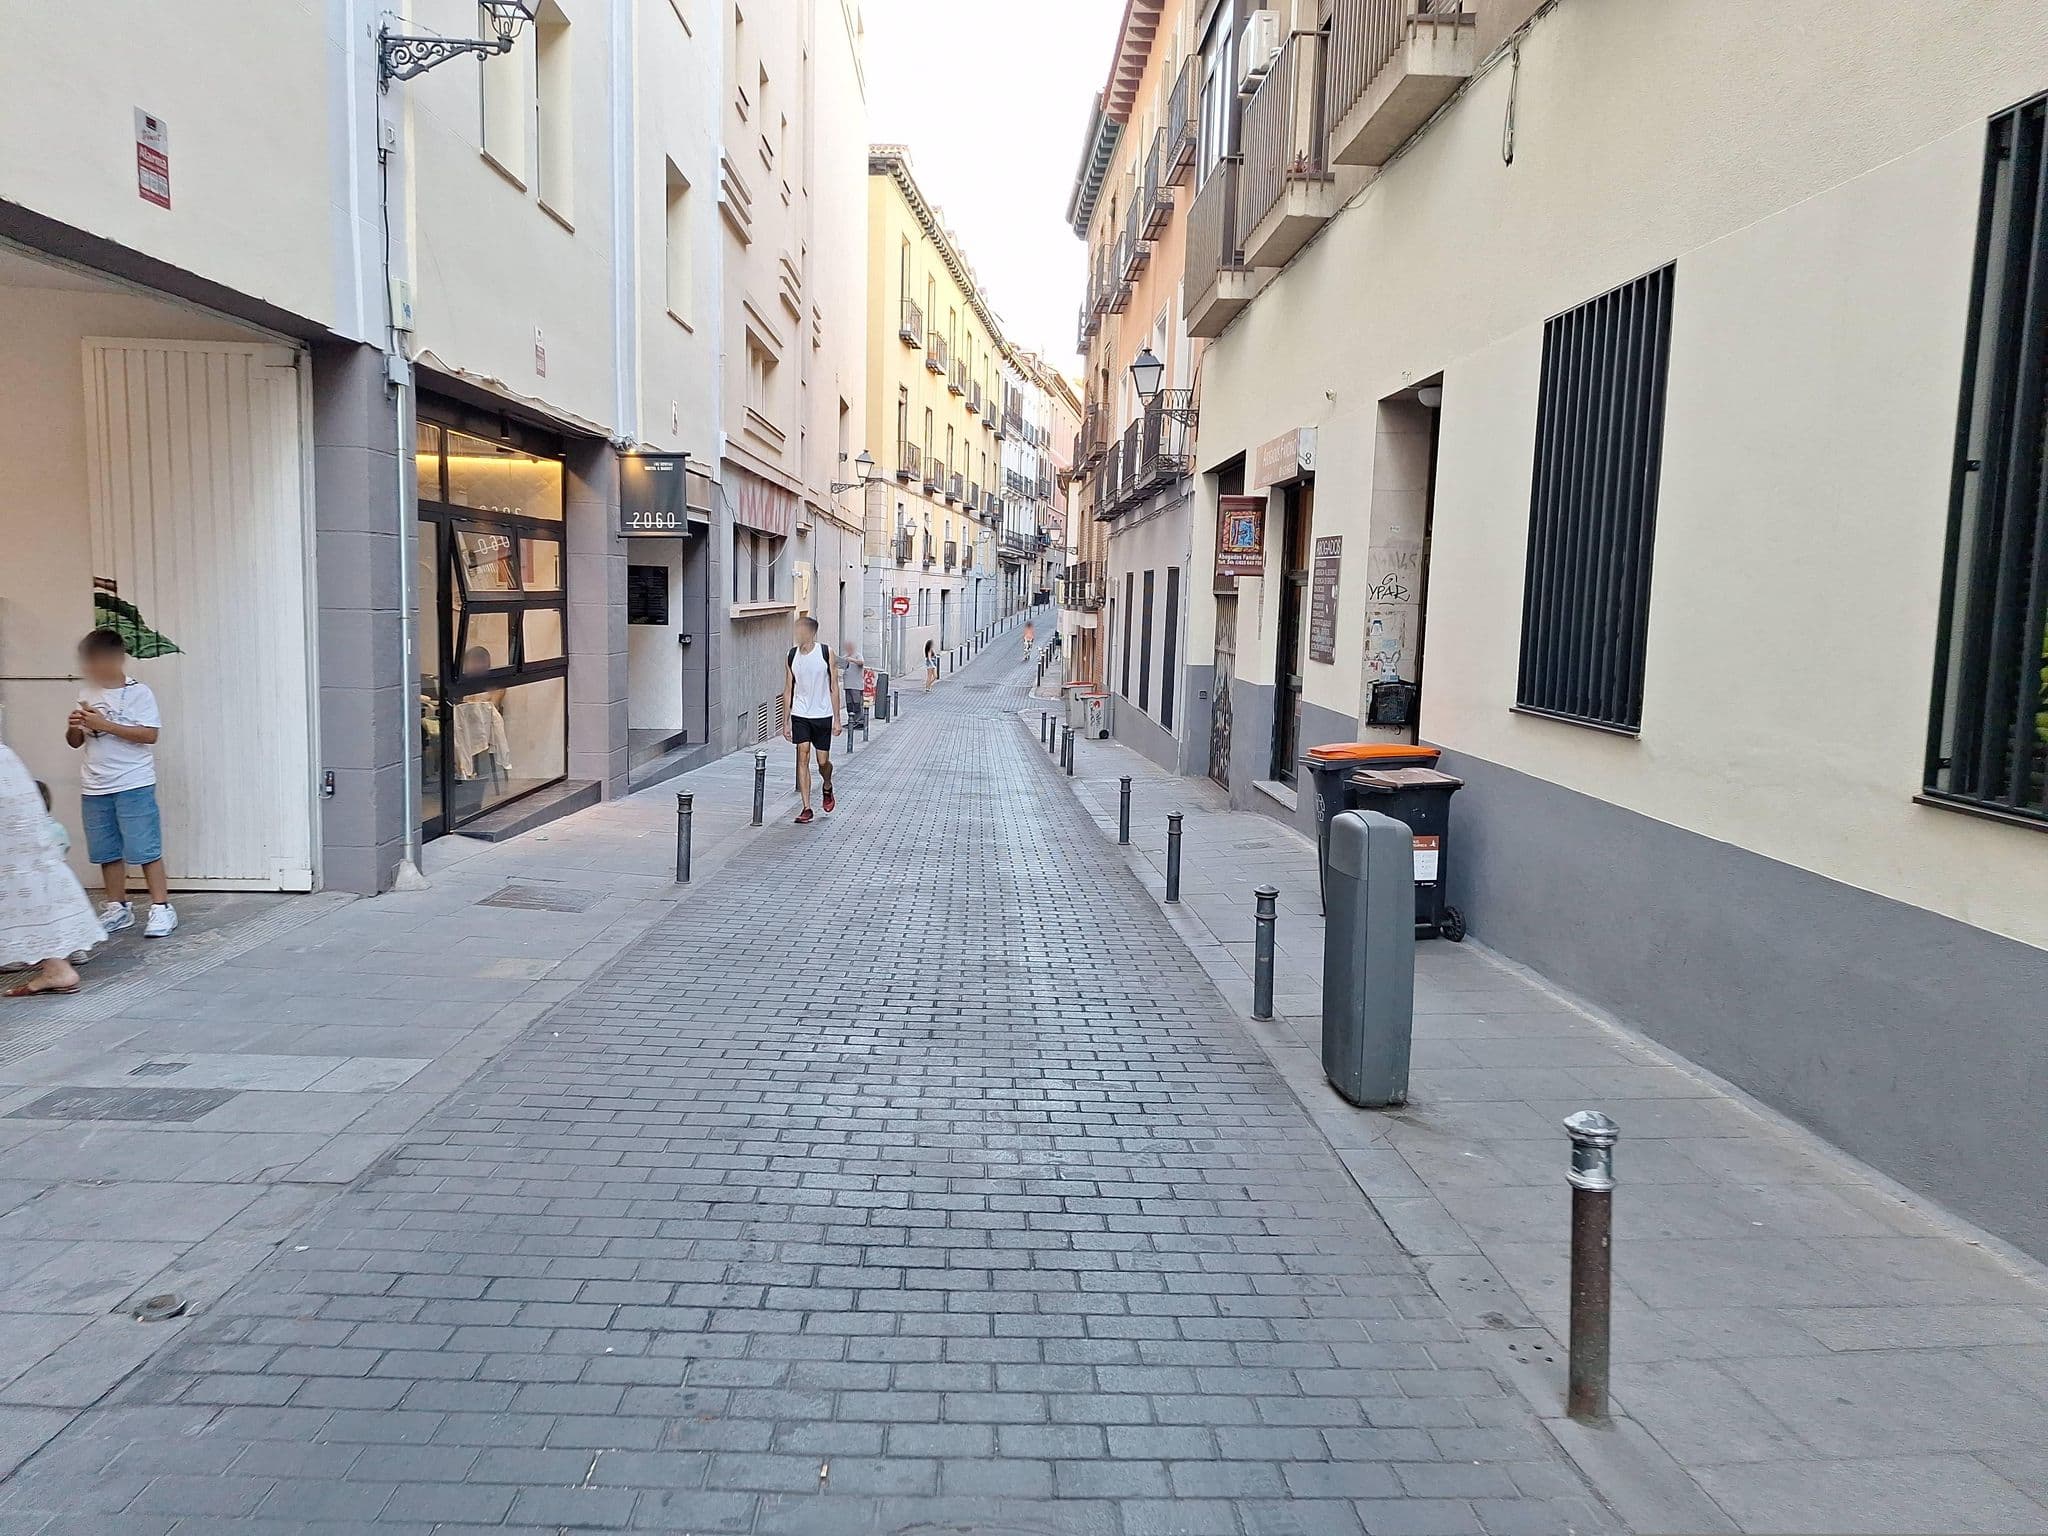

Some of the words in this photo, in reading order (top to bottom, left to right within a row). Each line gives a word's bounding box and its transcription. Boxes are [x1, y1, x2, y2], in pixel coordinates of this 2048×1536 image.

[1305, 452, 1312, 465] 8
[632, 511, 676, 530] 2060
[1316, 539, 1342, 556] ABOGADOS
